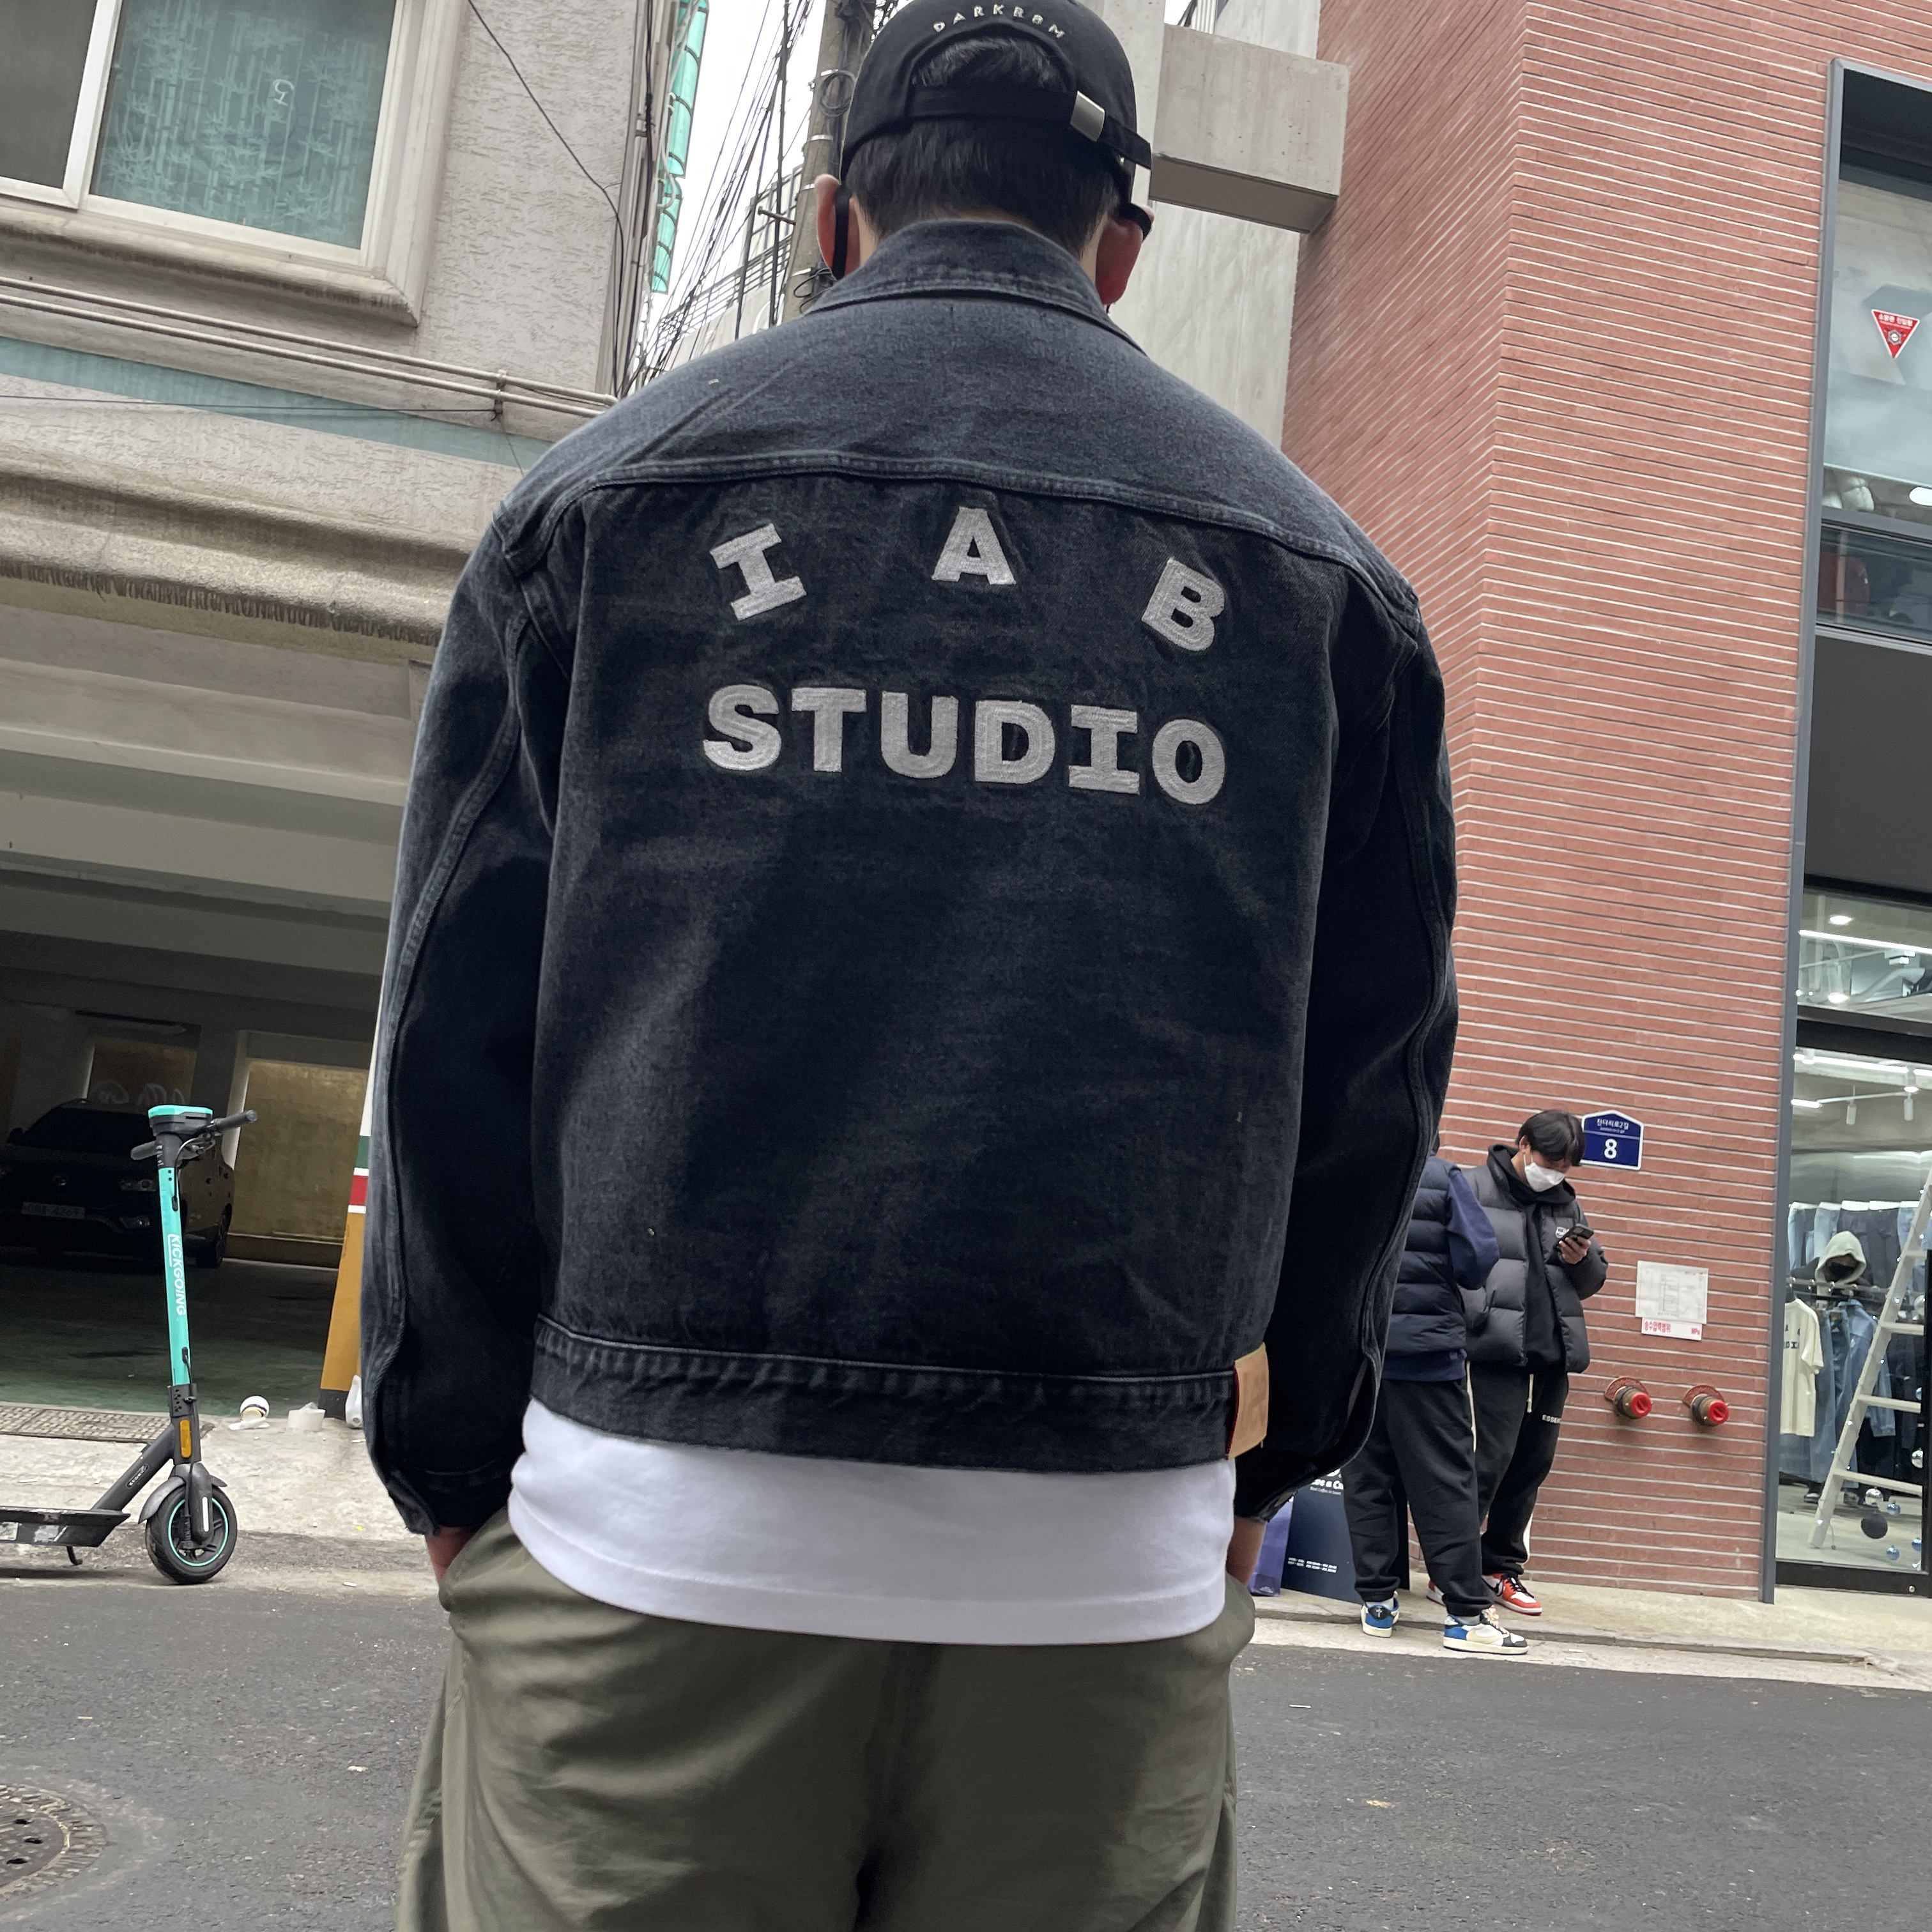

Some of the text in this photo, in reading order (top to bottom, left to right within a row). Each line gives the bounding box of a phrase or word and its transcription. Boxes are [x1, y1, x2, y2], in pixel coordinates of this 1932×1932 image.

[703, 684, 1226, 806] STUDIO
[1604, 1138, 1617, 1159] 8
[168, 1234, 187, 1315] KICKGOING
